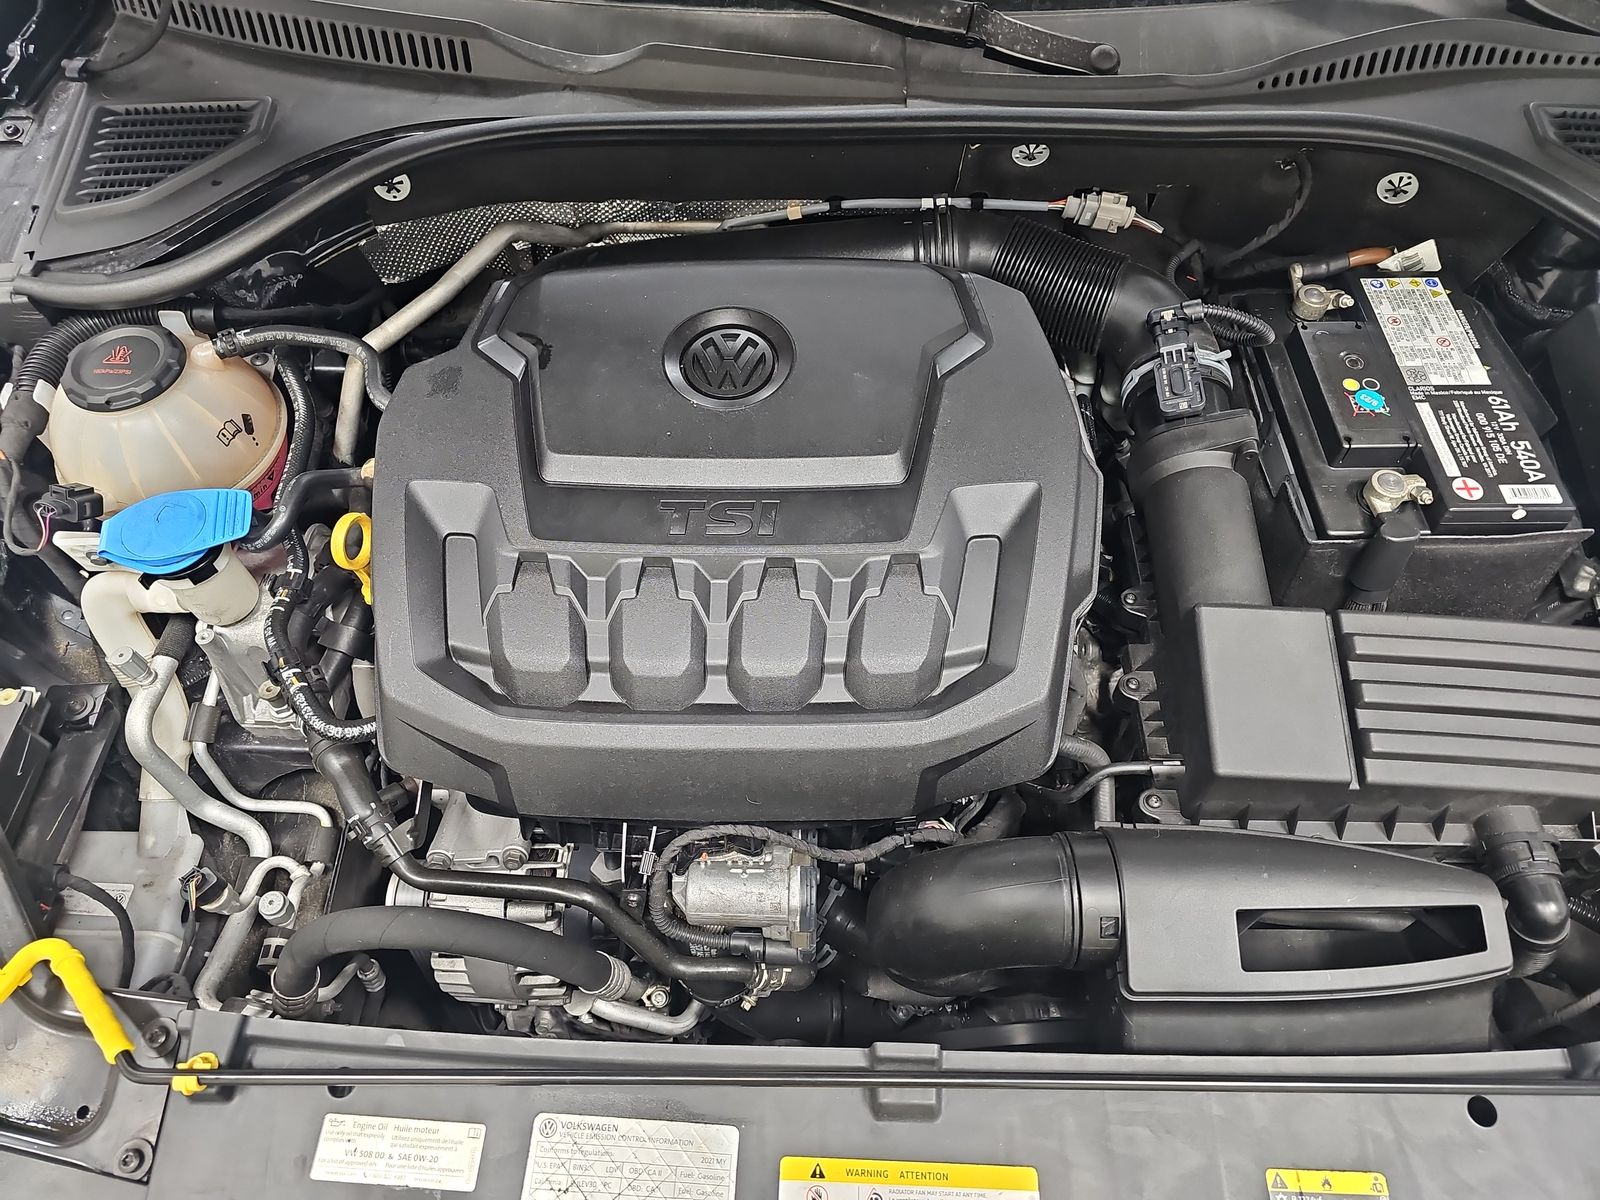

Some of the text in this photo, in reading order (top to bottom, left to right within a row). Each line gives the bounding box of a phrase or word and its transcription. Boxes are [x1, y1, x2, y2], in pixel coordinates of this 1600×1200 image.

[1455, 309, 1481, 349] DANGER/POISON
[1475, 413, 1508, 464] 000 915 105 DE
[1488, 396, 1519, 431] 61Ah
[1510, 440, 1546, 482] 540A
[254, 483, 268, 499] min
[658, 500, 780, 536] TSI
[352, 1121, 388, 1131] Engine Oil
[394, 1125, 413, 1133] Huile
[560, 1121, 618, 1132] VOLKSWAGEN
[560, 1131, 584, 1139] VEHICLE
[617, 1134, 648, 1143] CONTROL
[648, 1137, 694, 1146] INFORMATION
[359, 1150, 373, 1158] 508
[374, 1151, 385, 1159] 00
[397, 1153, 412, 1161] SAE
[413, 1154, 439, 1163] 0W-20
[539, 1145, 570, 1154] Conforms
[571, 1147, 578, 1155] to
[700, 1156, 715, 1164] 2021
[697, 1173, 725, 1181] Gasoline
[845, 1168, 949, 1181] WARNING ATTENTION
